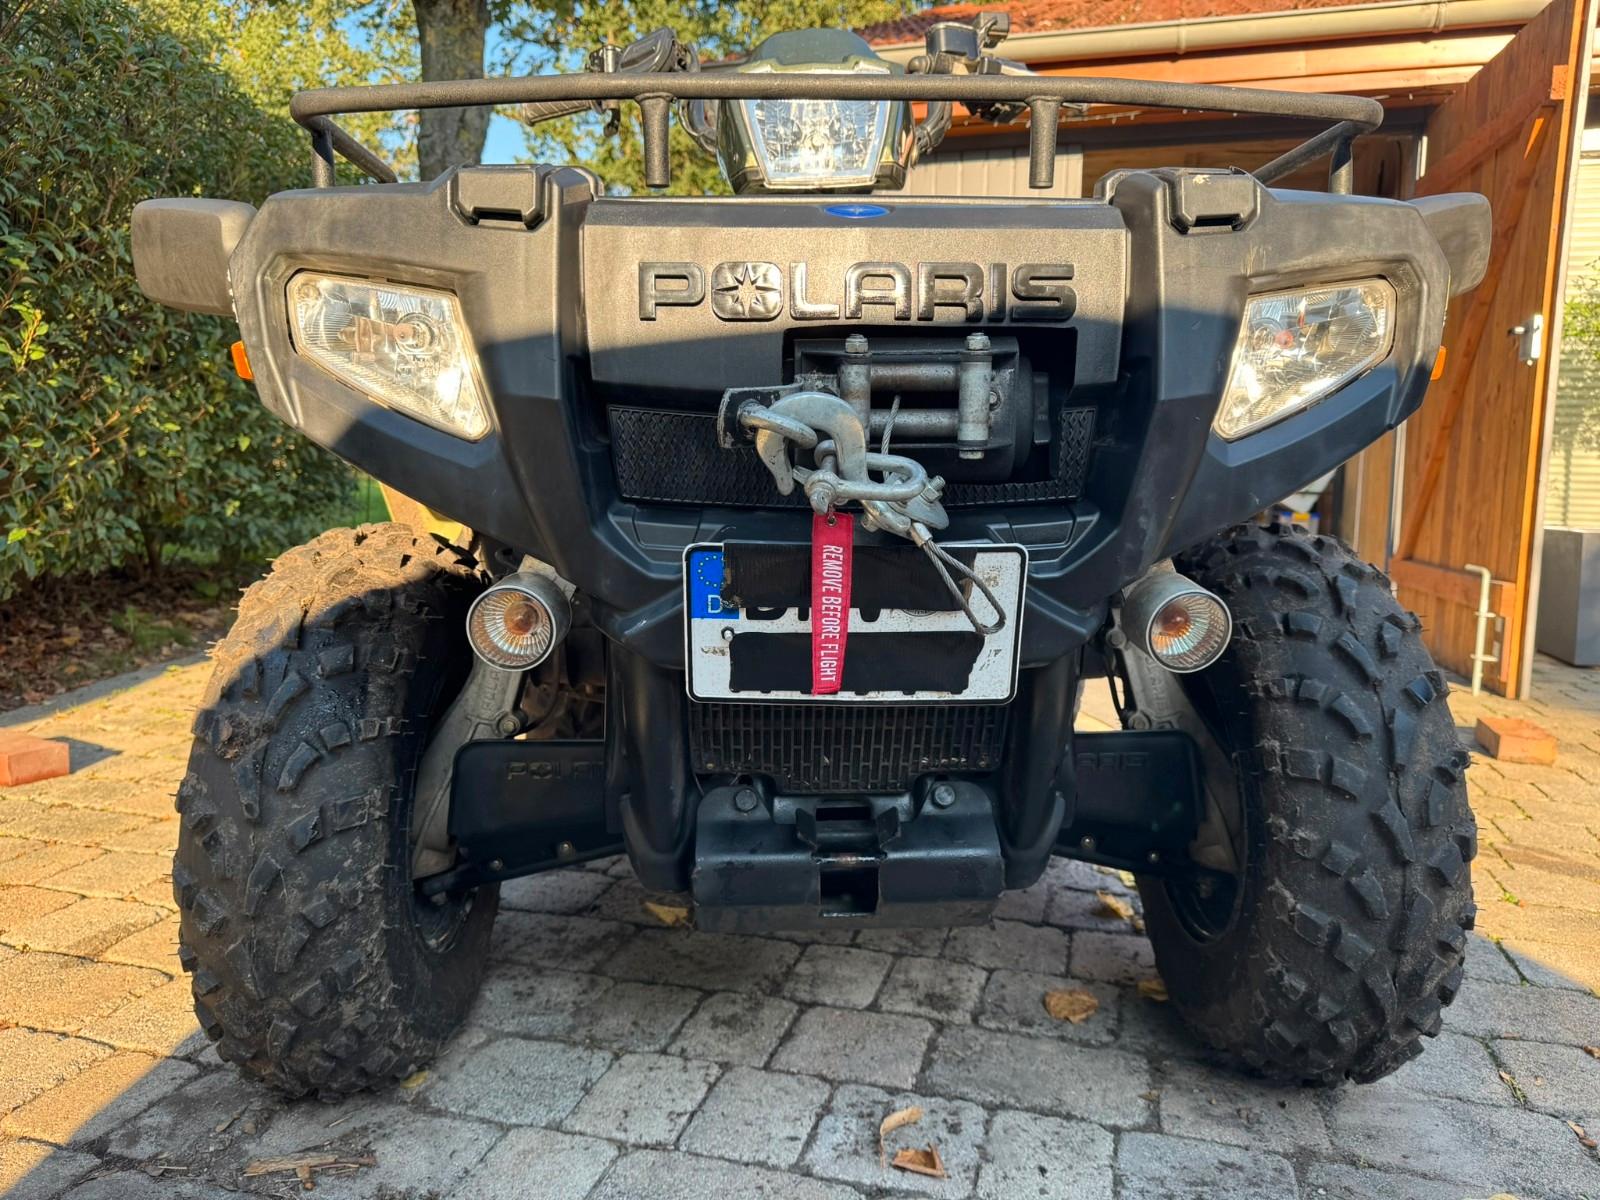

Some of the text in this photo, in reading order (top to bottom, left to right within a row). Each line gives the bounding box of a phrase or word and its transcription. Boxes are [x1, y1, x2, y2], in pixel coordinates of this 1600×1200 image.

[638, 261, 1077, 322] POLARIS
[707, 594, 723, 614] D
[820, 544, 843, 682] REMOVE BEFORE FLIGHT
